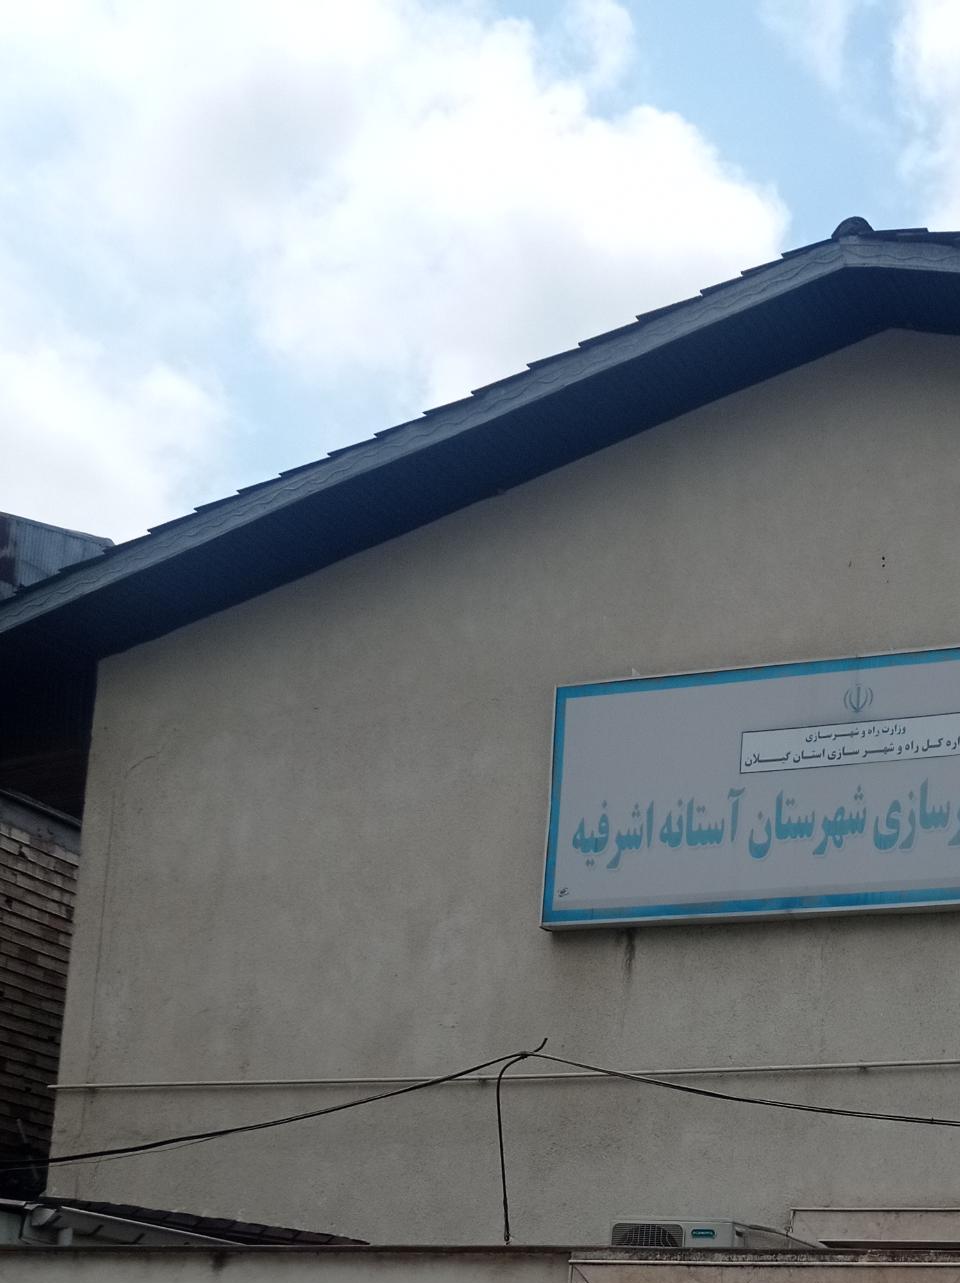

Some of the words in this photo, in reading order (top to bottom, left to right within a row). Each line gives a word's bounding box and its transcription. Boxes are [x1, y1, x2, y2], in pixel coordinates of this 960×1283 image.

[861, 729, 866, 738] و
[867, 726, 880, 737] راه
[881, 723, 906, 736] وزارت
[896, 744, 902, 755] و
[905, 740, 919, 754] راه
[921, 737, 944, 752] کل
[792, 748, 825, 763] استان
[660, 787, 745, 849] آستانه
[749, 785, 867, 859] شهرستان
[572, 800, 654, 869] اشرفیه
